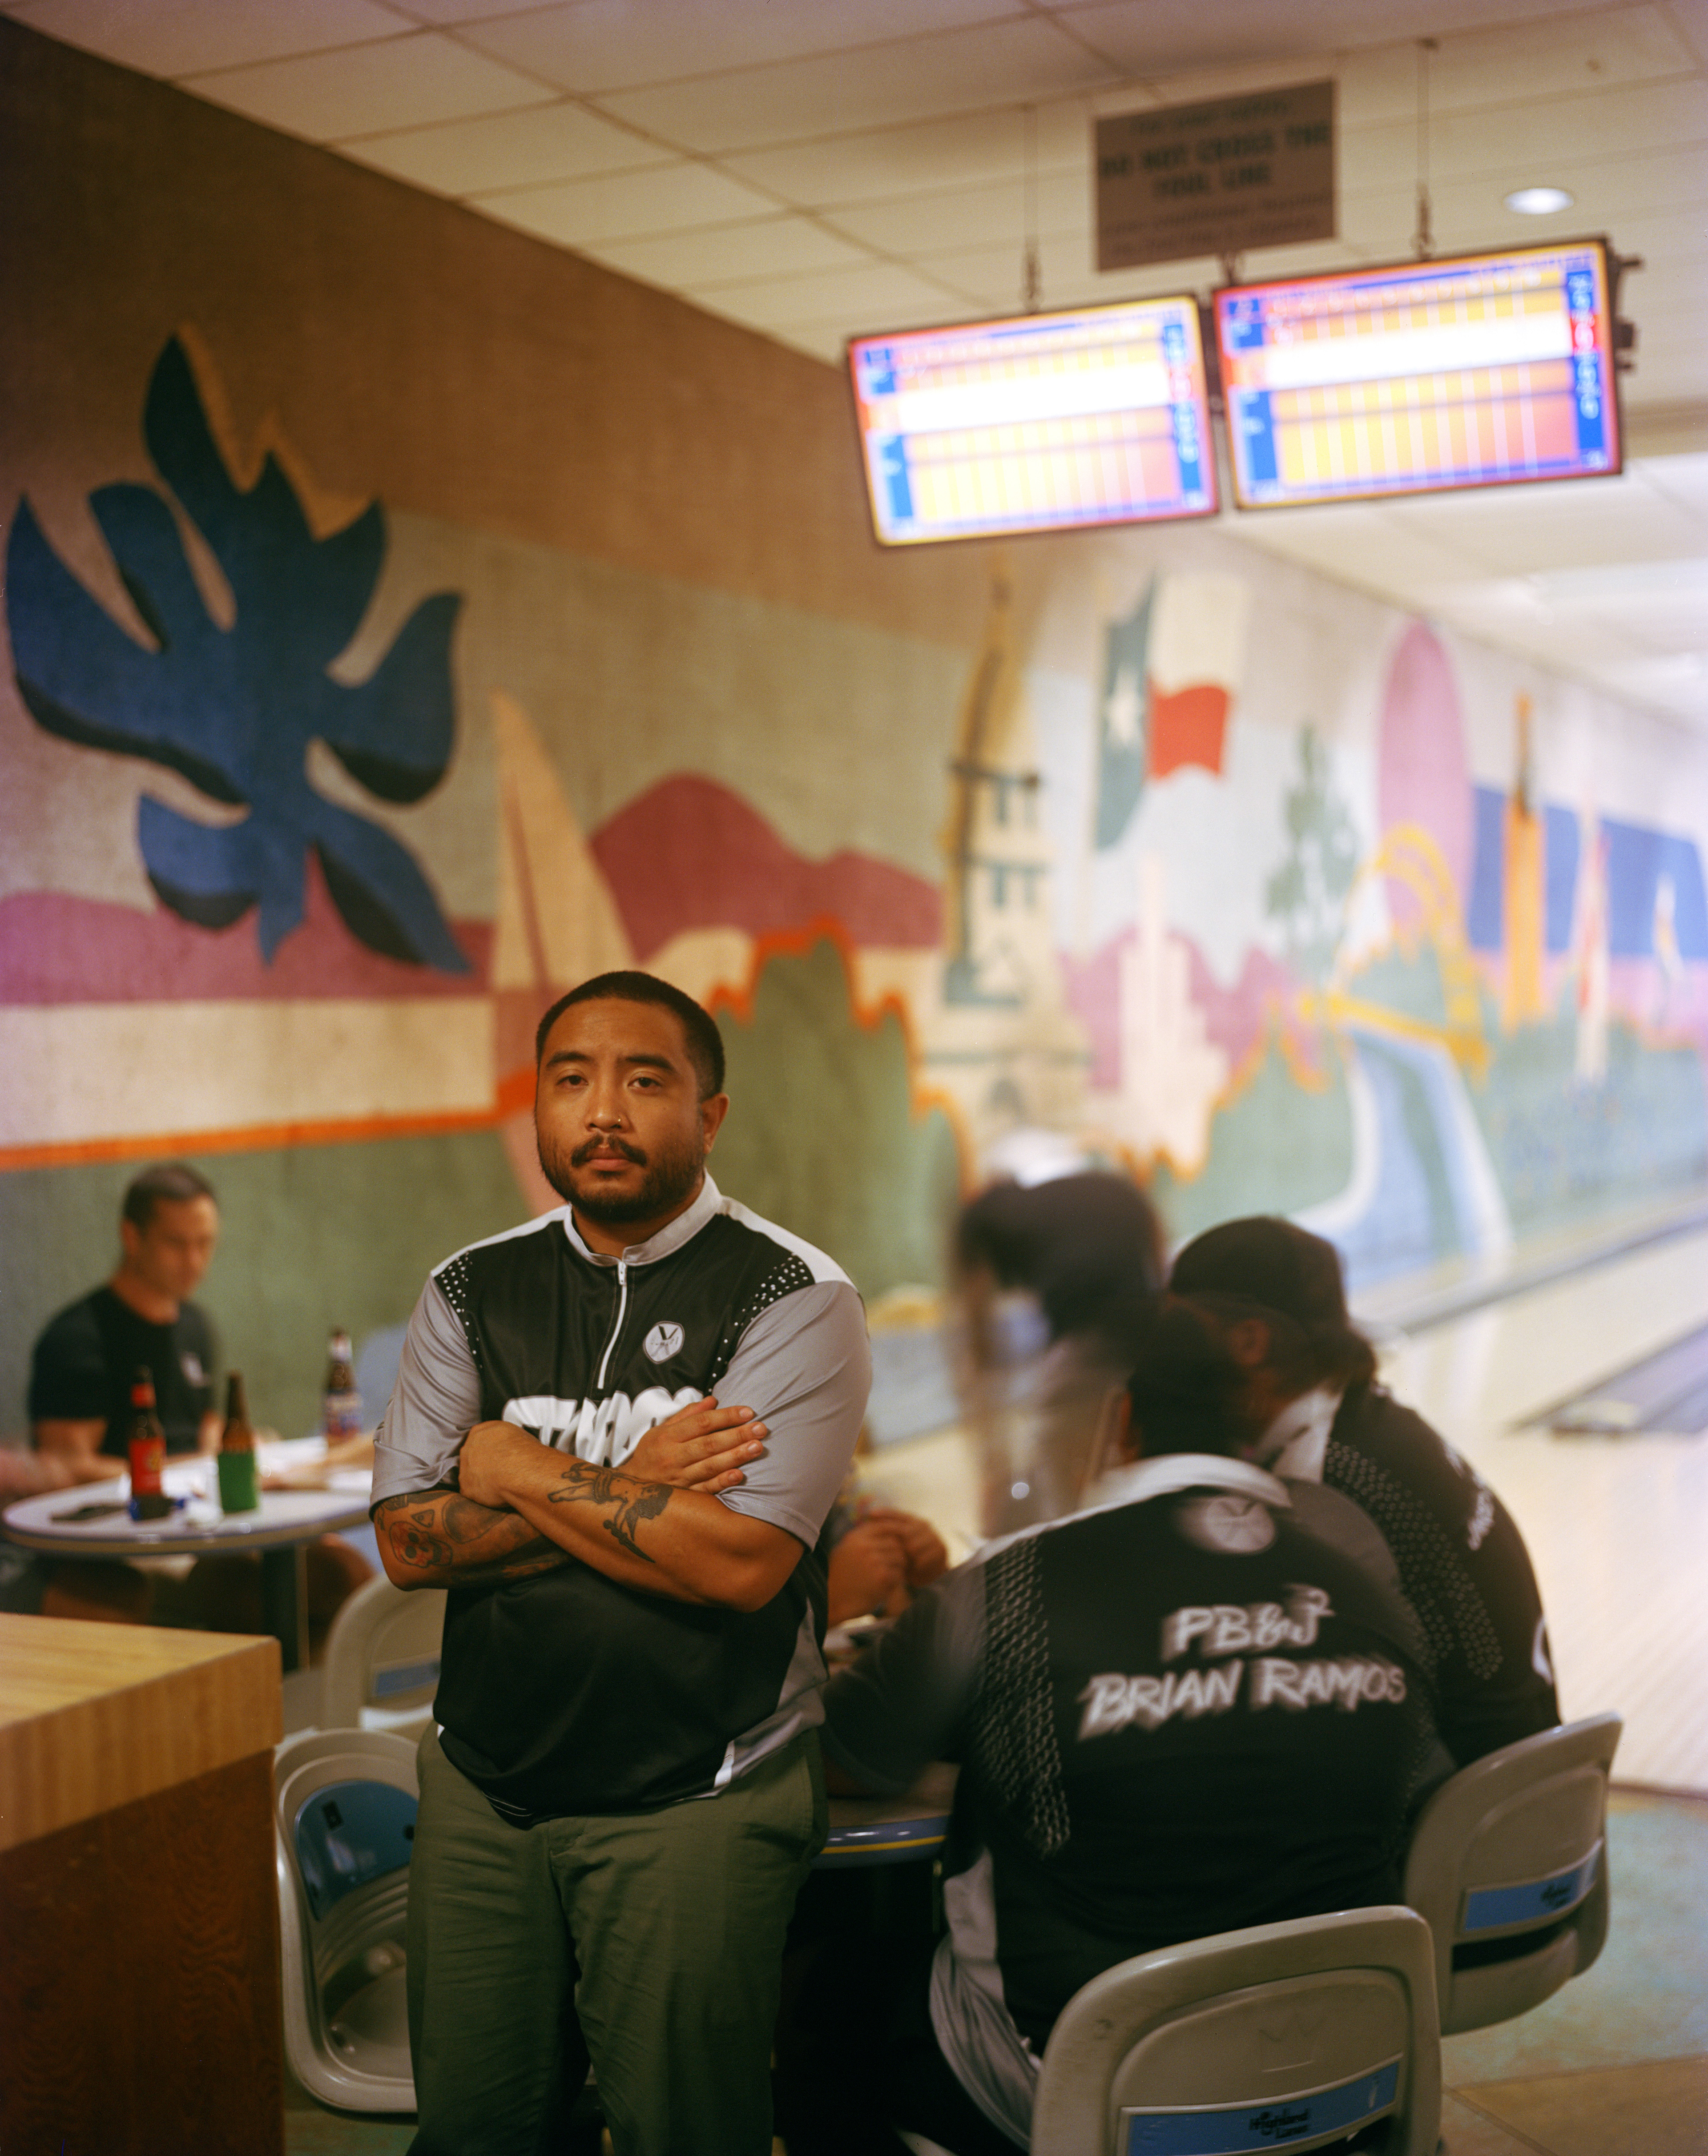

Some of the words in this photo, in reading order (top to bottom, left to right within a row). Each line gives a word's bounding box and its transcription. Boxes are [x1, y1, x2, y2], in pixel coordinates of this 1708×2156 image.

[1164, 1583, 1333, 1662] PB&J
[1078, 1659, 1245, 1741] BRIAN
[1251, 1656, 1407, 1712] RAMOS
